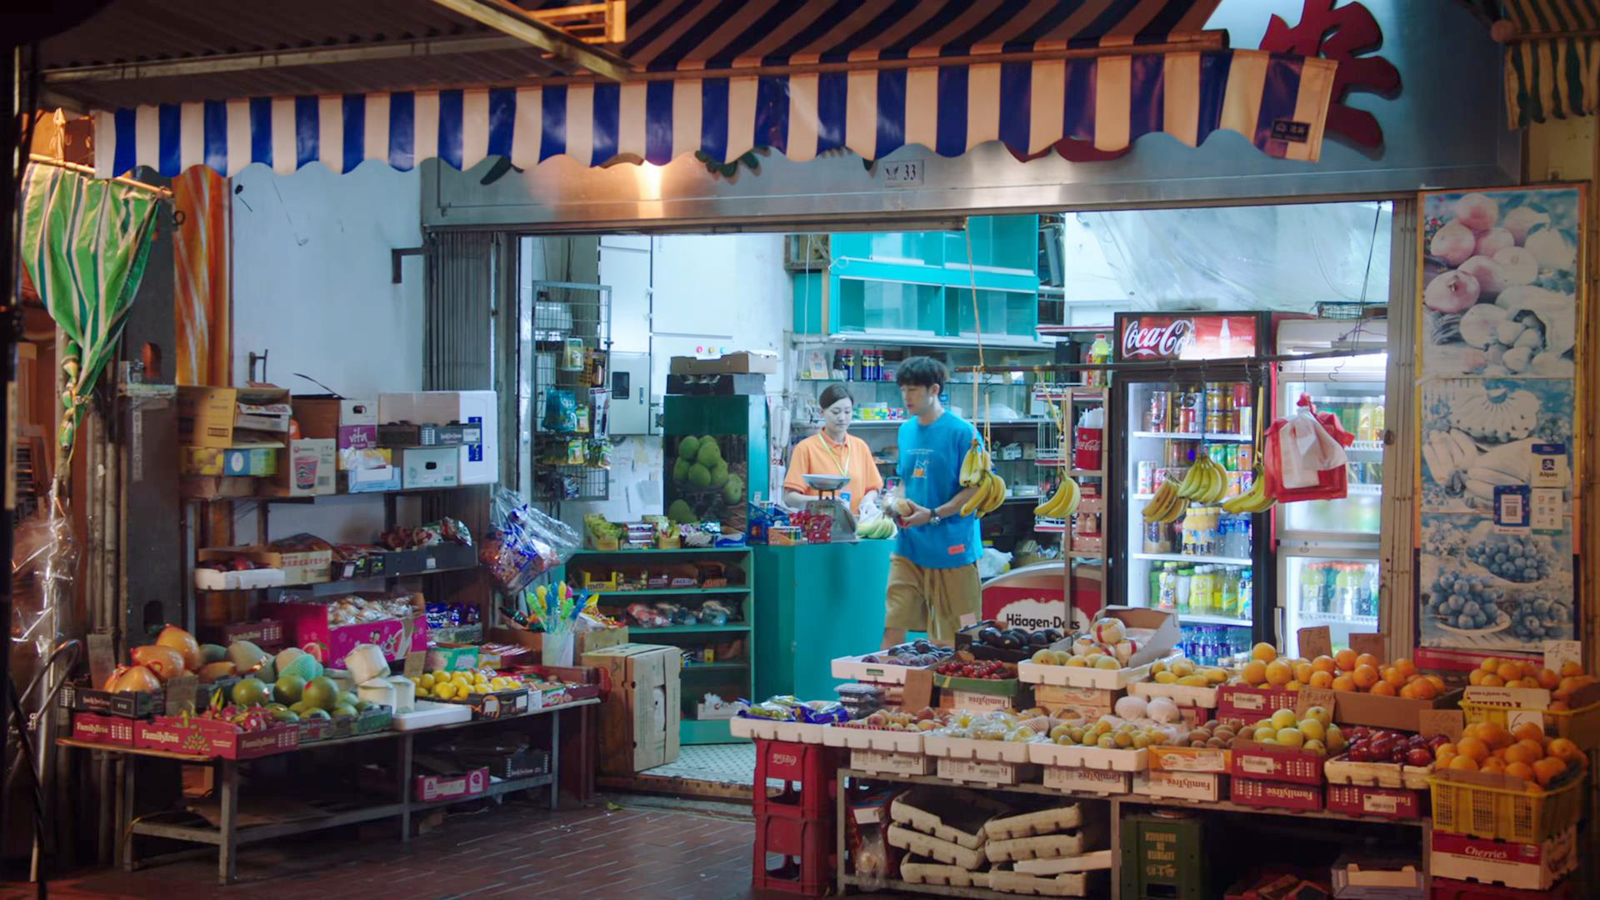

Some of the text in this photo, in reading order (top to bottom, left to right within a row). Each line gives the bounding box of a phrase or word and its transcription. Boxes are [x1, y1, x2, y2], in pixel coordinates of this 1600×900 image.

[903, 164, 916, 181] 33
[76, 722, 108, 734] FamilyTree
[142, 729, 179, 743] FamilyTree
[1078, 769, 1121, 783] FamilyTree
[1167, 777, 1211, 791] FamilyTree
[1266, 786, 1313, 801] FamilyTree
[1465, 845, 1508, 859] Cherries
